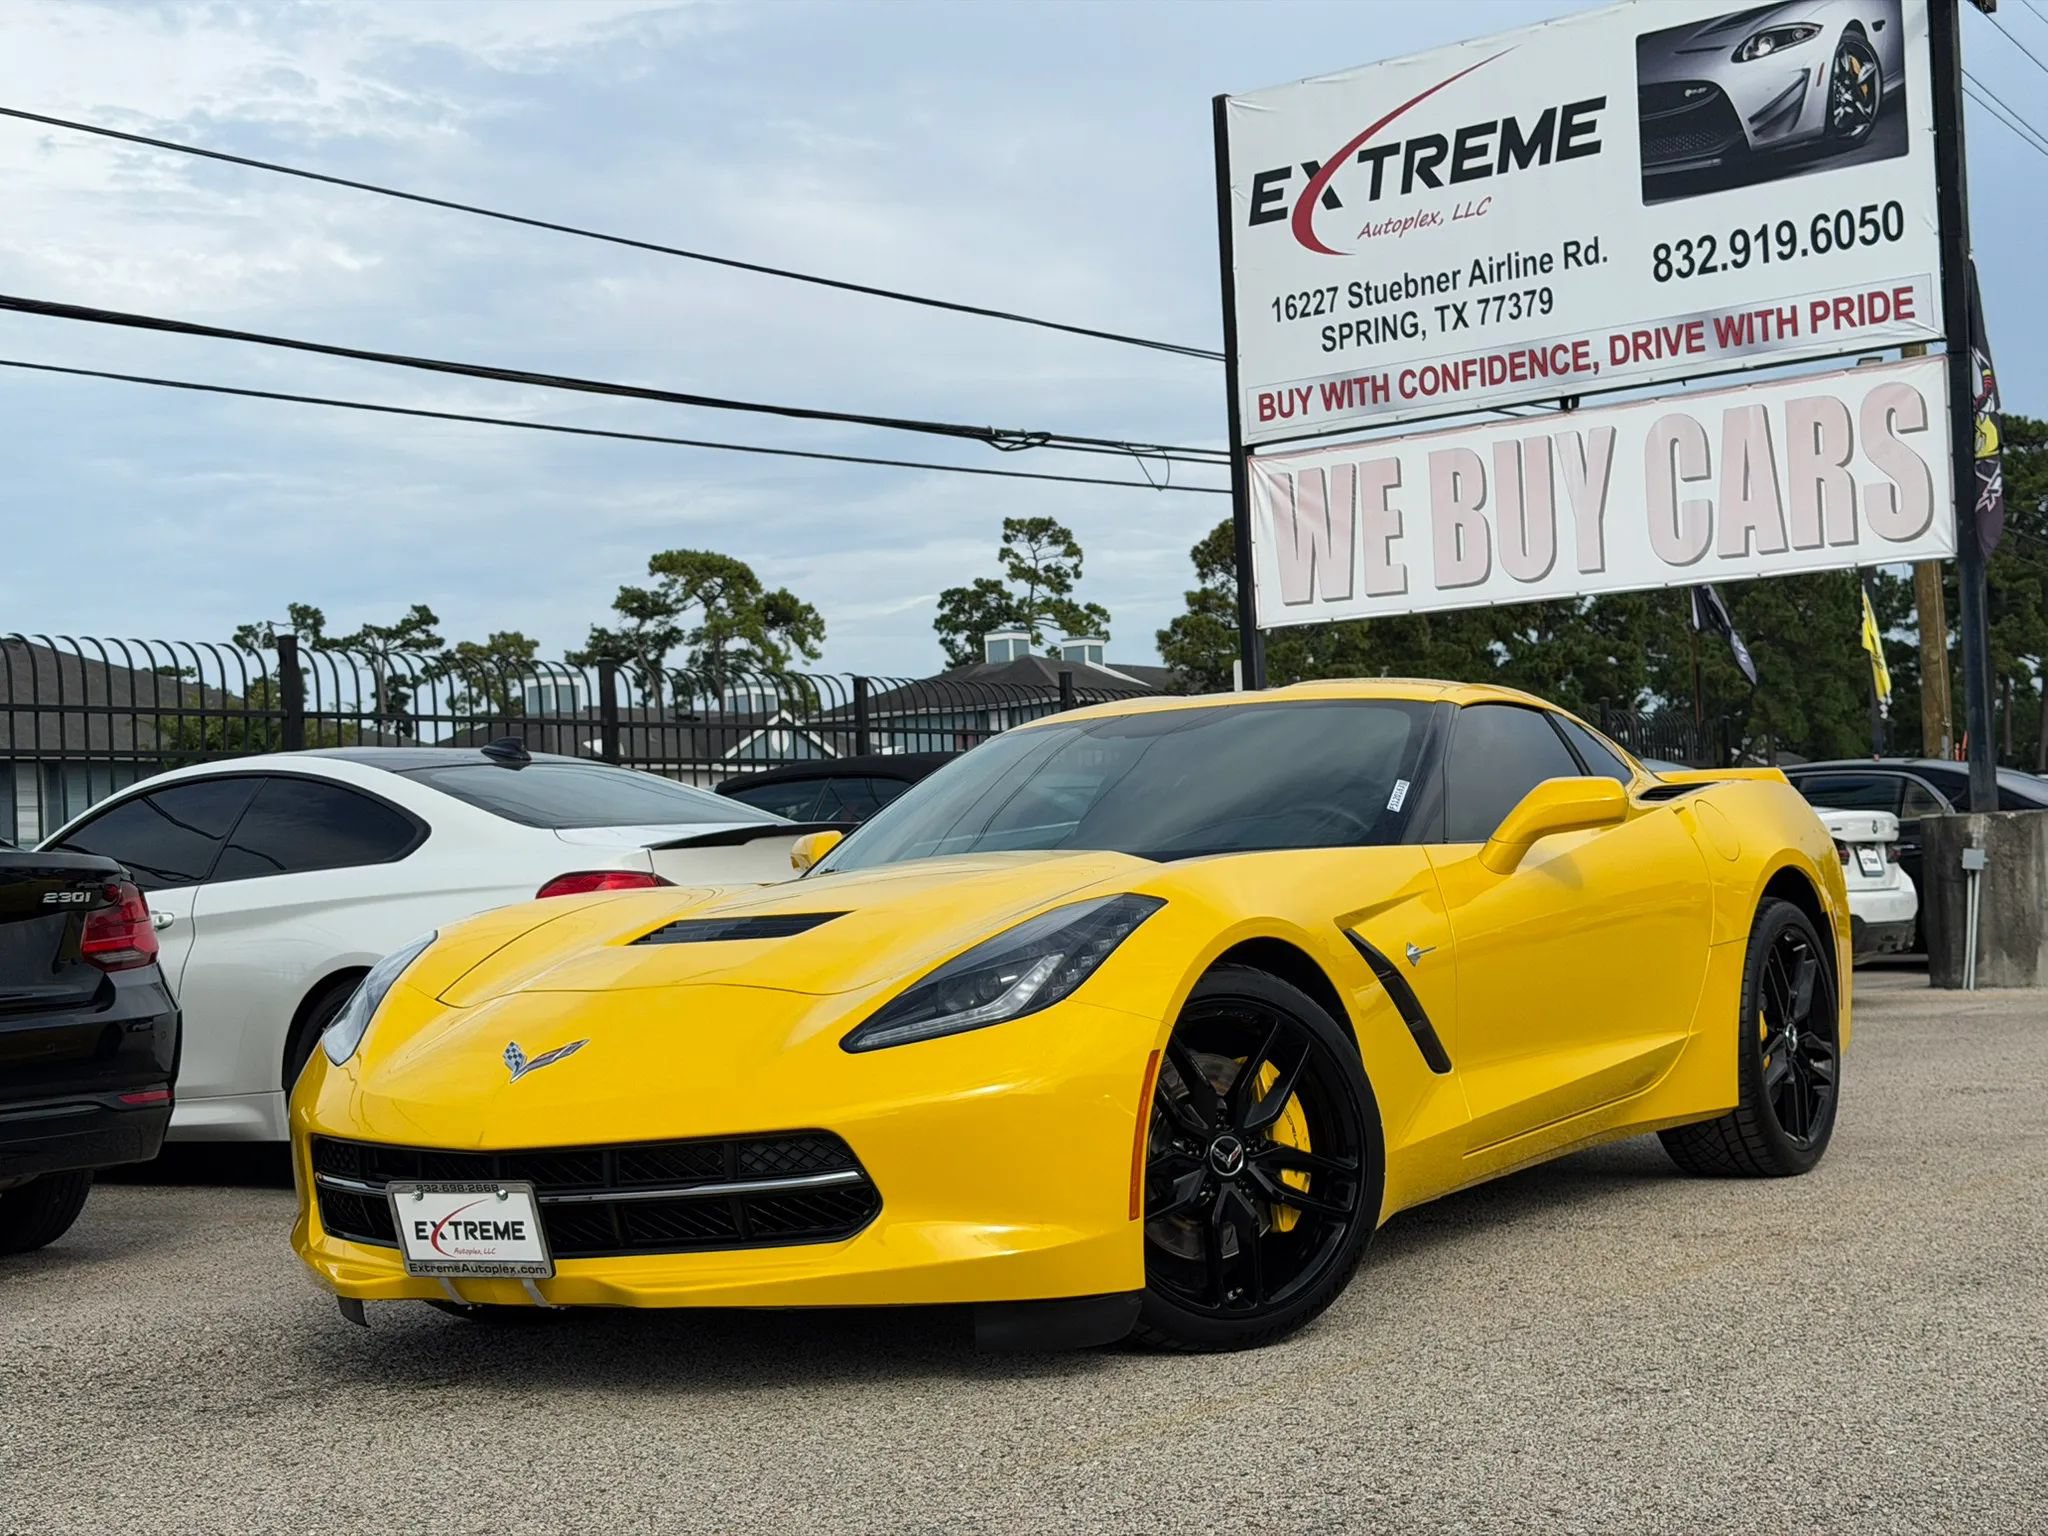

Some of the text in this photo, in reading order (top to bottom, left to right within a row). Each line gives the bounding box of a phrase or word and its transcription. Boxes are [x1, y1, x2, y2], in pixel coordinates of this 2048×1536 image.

[1249, 94, 1608, 227] EXTREME
[1356, 196, 1492, 240] Autoplex, LLC
[1652, 200, 1905, 283] 832.919.6050
[1271, 236, 1609, 323] 16227 Stuebner Airline Rd.
[1258, 286, 1915, 422] BUY WITH CONFIDENCE, DRIVE WITH PRIDE
[1320, 286, 1554, 353] SPRING, TX 77379
[1270, 381, 1934, 606] WE BUY CARS
[409, 1262, 548, 1275] ExtremeAutoplex.com
[414, 1221, 526, 1241] EXTREME
[483, 1247, 497, 1255] LLC
